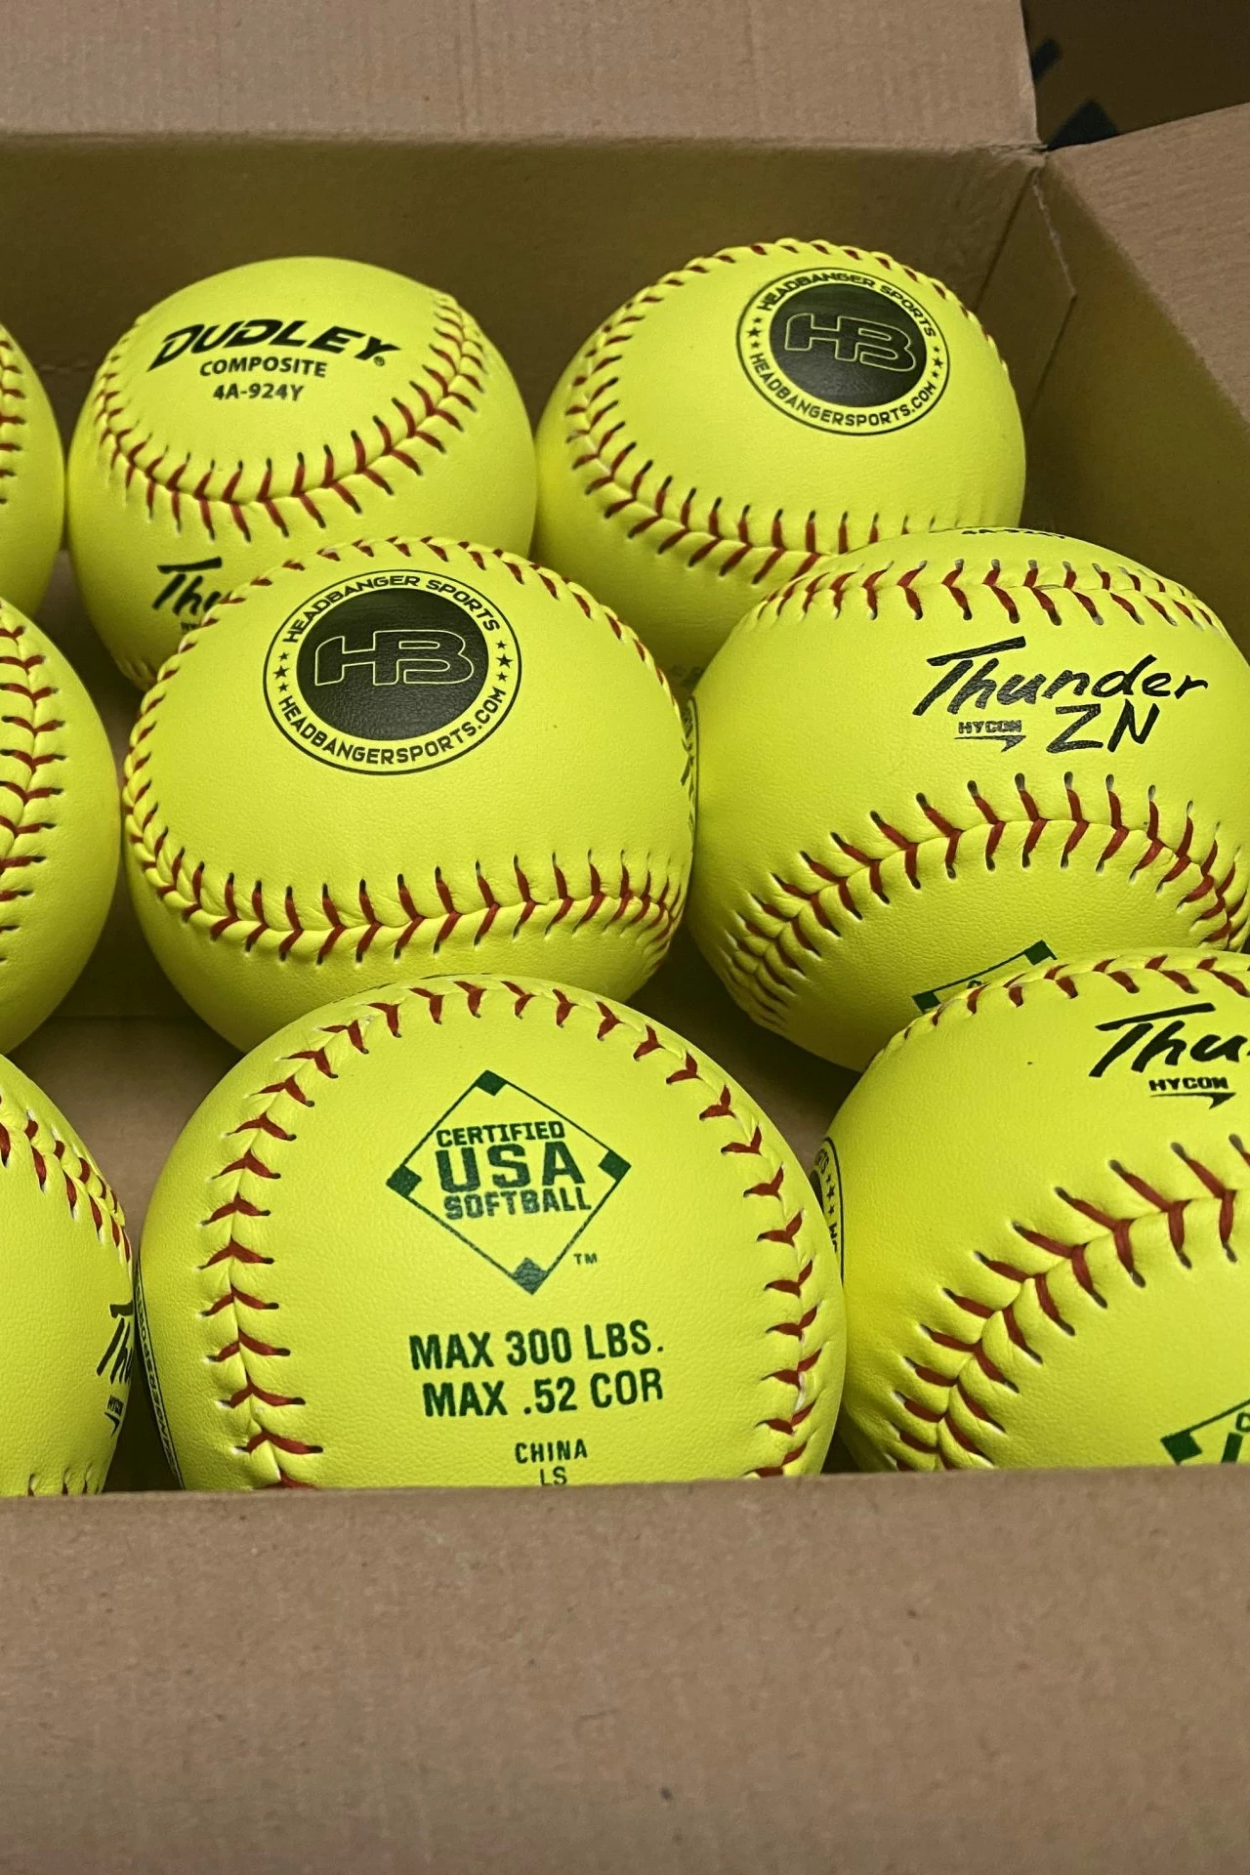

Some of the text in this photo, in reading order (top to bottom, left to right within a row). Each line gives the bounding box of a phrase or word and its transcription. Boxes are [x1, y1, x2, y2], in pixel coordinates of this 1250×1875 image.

[757, 272, 937, 338] HEADBANGER SPORTS
[200, 356, 328, 378] COMPOSITE
[785, 313, 917, 372] HB
[212, 383, 304, 401] 4A-924Y
[750, 352, 937, 427] HEADBANGERSPORTS.COM
[283, 575, 501, 644] HEADBANGER SPORTS
[314, 629, 475, 686] HB
[912, 635, 1209, 716] Thunder
[278, 687, 506, 765] HEADBANGERSPORTS.COM
[1046, 698, 1160, 753] ZN
[1089, 1002, 1250, 1078] Thu
[1149, 1076, 1229, 1091] HYCON
[436, 1120, 565, 1148] CERTIFIED
[435, 1140, 586, 1193] USA
[443, 1185, 592, 1221] SOFTBALL
[409, 1319, 664, 1371] MAX 300 LBS.
[422, 1367, 664, 1418] MAX .52 COR
[515, 1439, 588, 1464] CHINA
